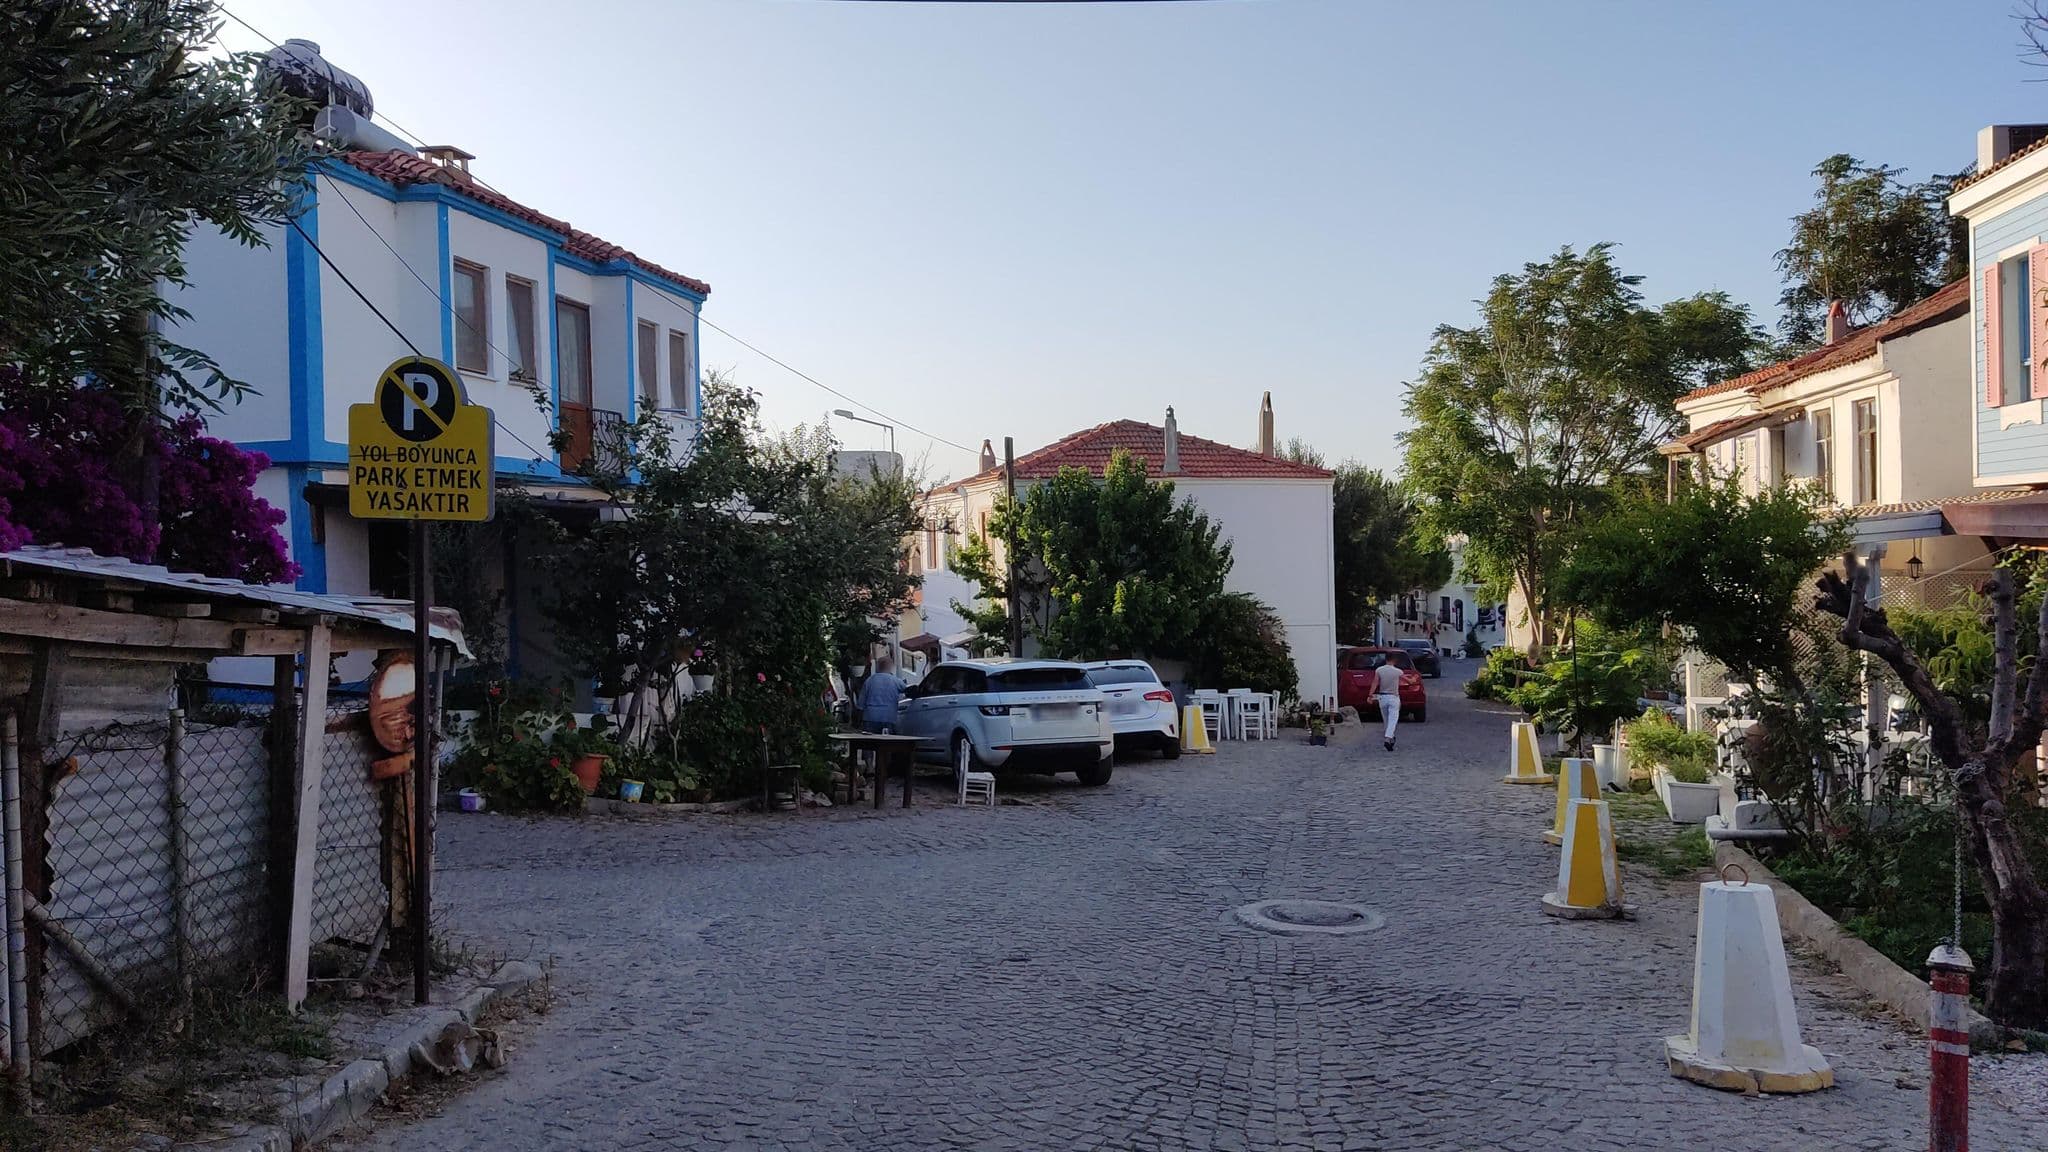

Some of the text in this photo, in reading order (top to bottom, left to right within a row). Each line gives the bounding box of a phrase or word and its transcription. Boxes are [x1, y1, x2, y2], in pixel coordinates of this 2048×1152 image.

[360, 445, 477, 465] YOL BOYUNCA
[355, 466, 482, 489] PARK ETMEK
[367, 491, 470, 513] YASAKTIR
